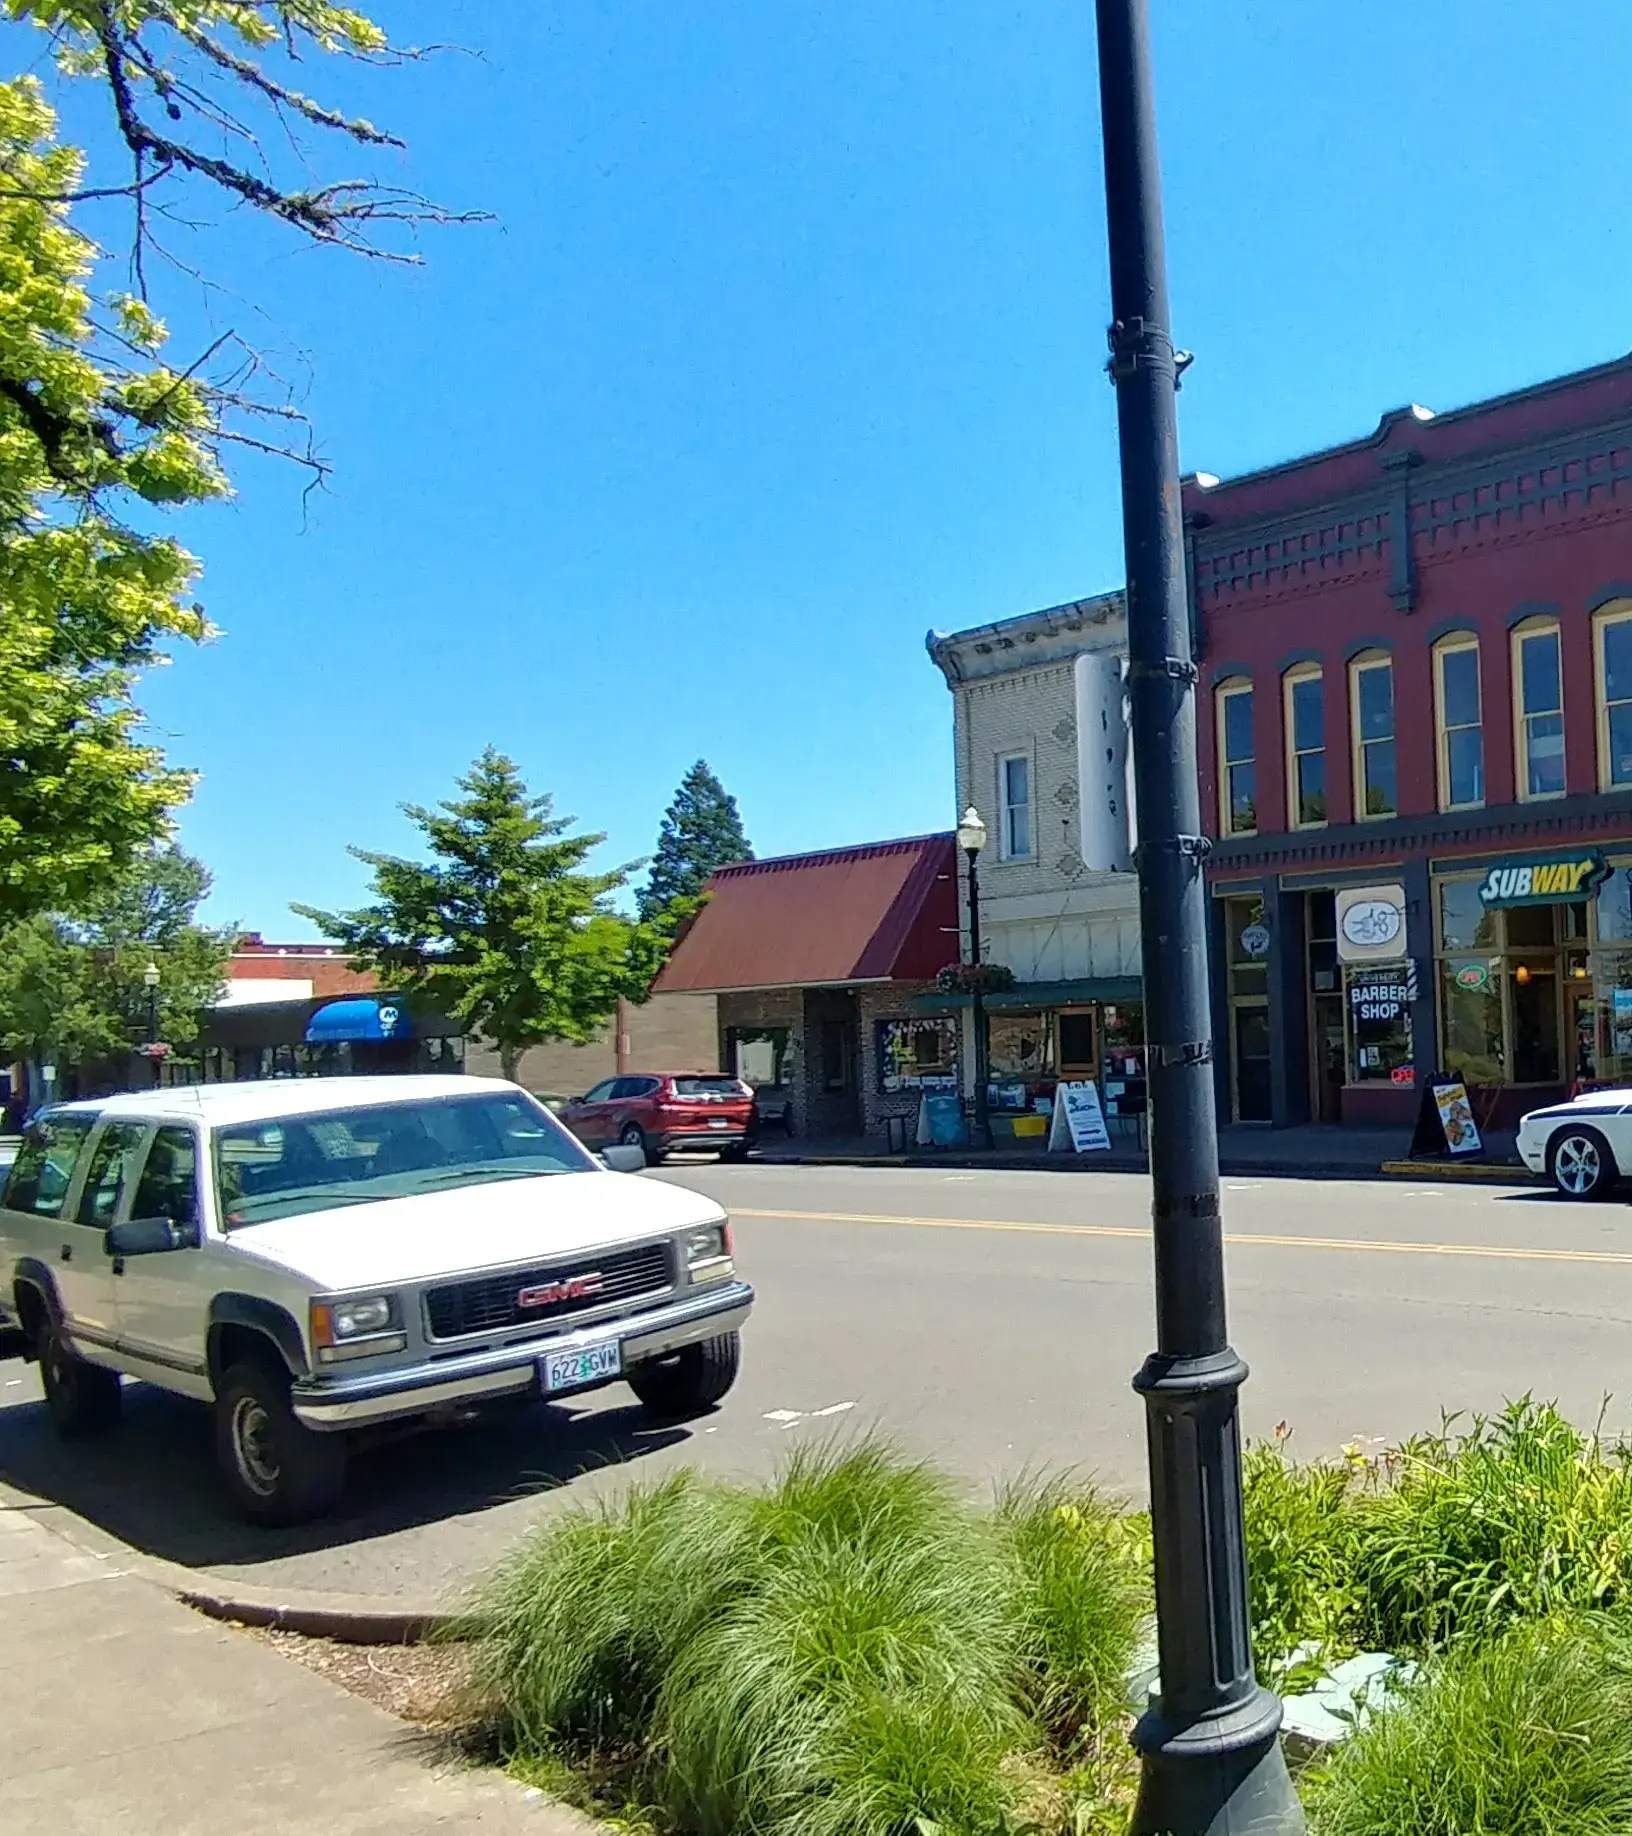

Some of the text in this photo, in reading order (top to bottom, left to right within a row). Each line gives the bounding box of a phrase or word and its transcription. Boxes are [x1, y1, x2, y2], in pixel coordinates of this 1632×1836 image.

[1481, 859, 1594, 900] SUBWAY
[1351, 985, 1407, 1003] BARBER
[1360, 1003, 1399, 1019] SHOP
[518, 1272, 602, 1308] GMC
[552, 1358, 580, 1381] 622
